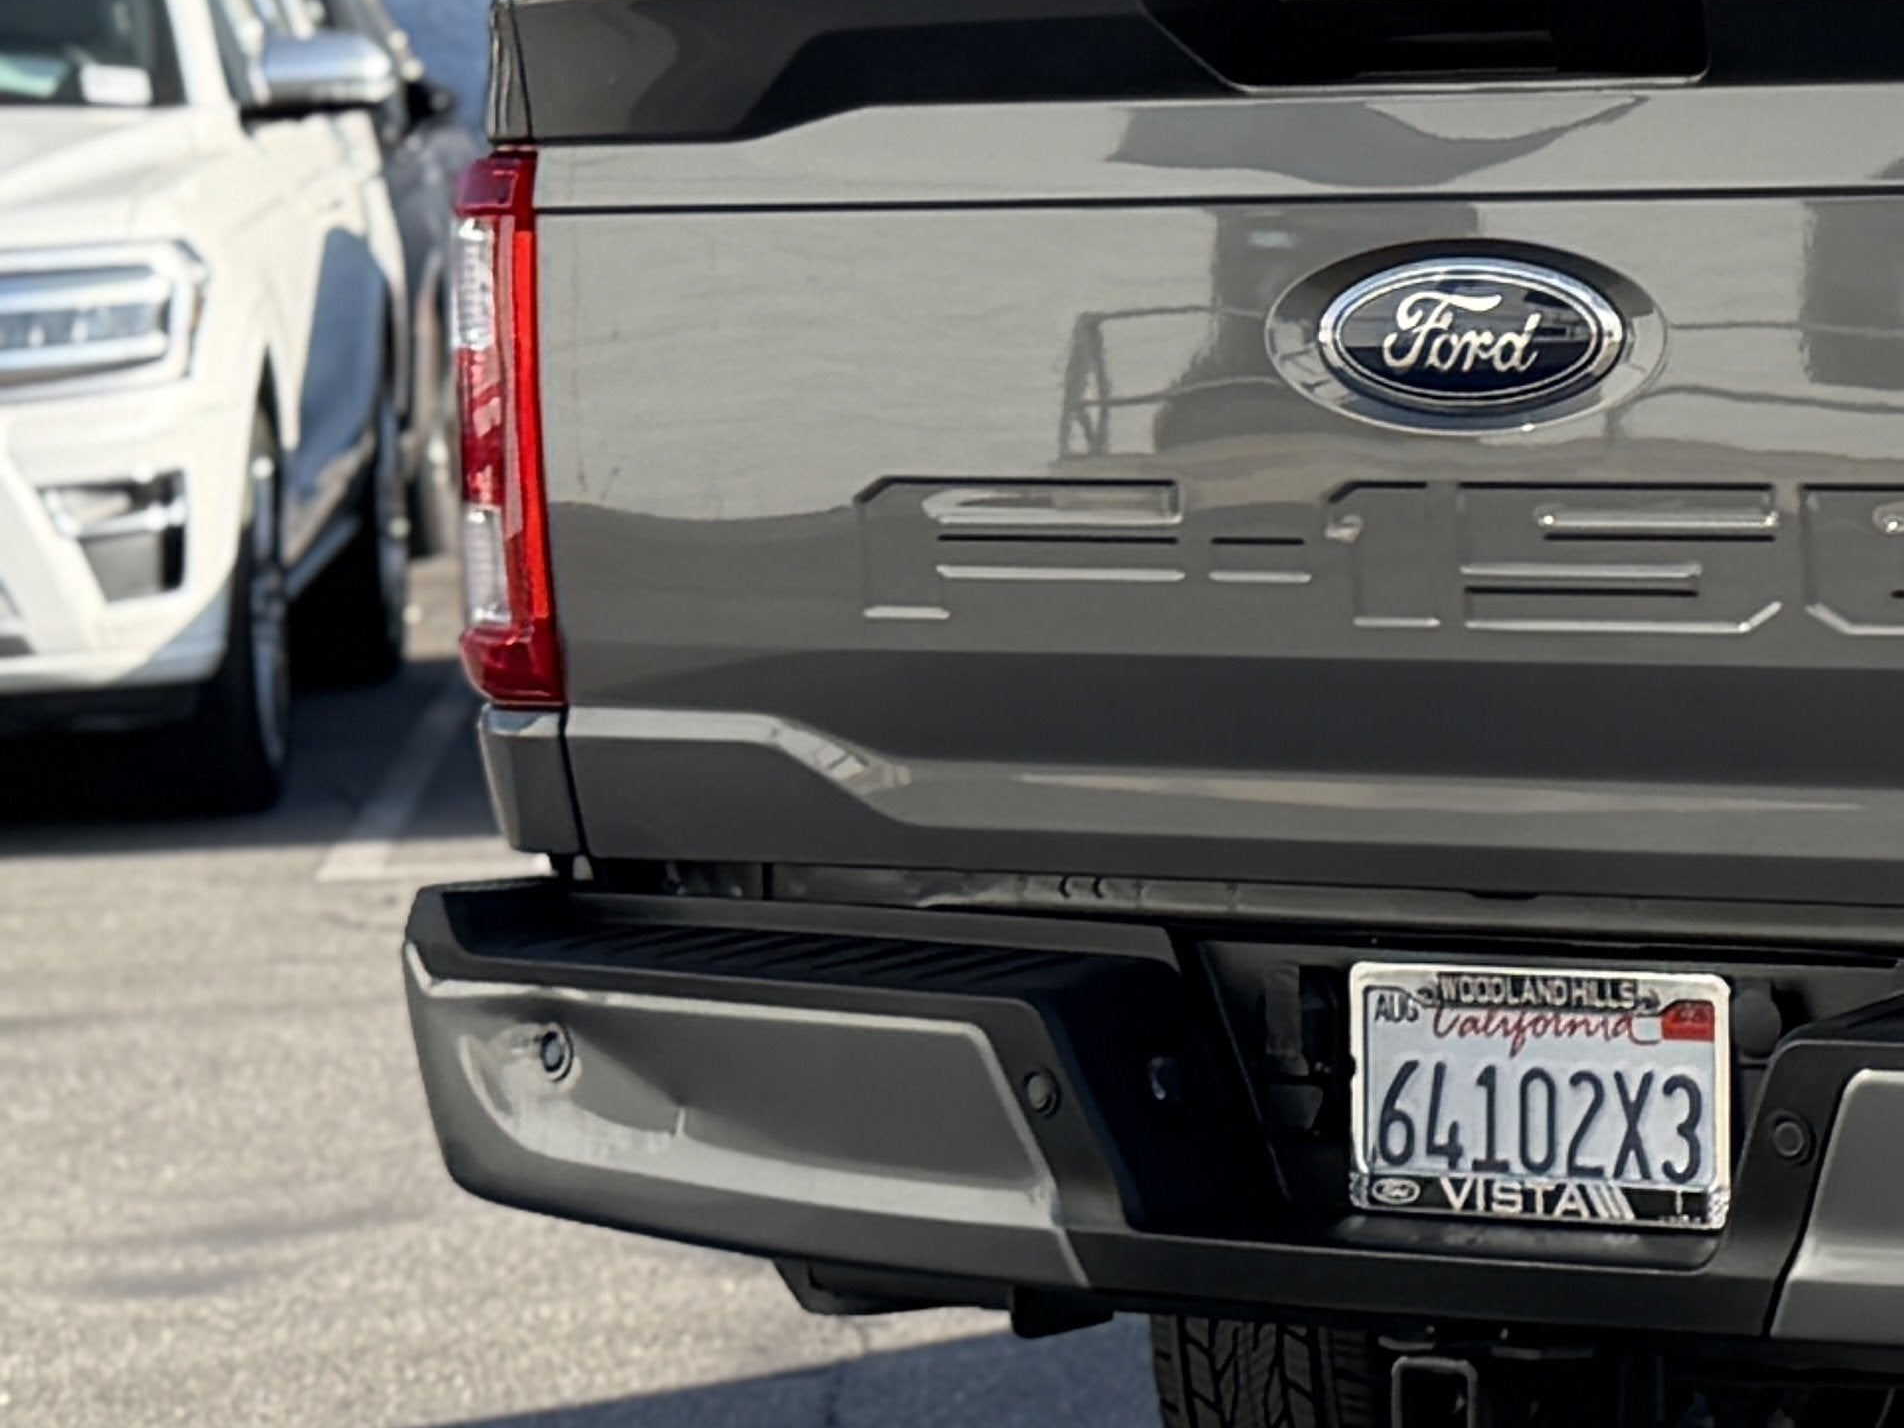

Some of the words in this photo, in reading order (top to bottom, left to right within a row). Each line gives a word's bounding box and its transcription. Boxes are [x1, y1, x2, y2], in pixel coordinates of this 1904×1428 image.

[1382, 290, 1542, 372] Ford
[1440, 974, 1568, 1007] WOODLAND
[1571, 979, 1636, 1010] HILLS
[1432, 1006, 1637, 1058] California
[1377, 1059, 1702, 1184] 64102X3
[1439, 1175, 1591, 1221] VISTA
